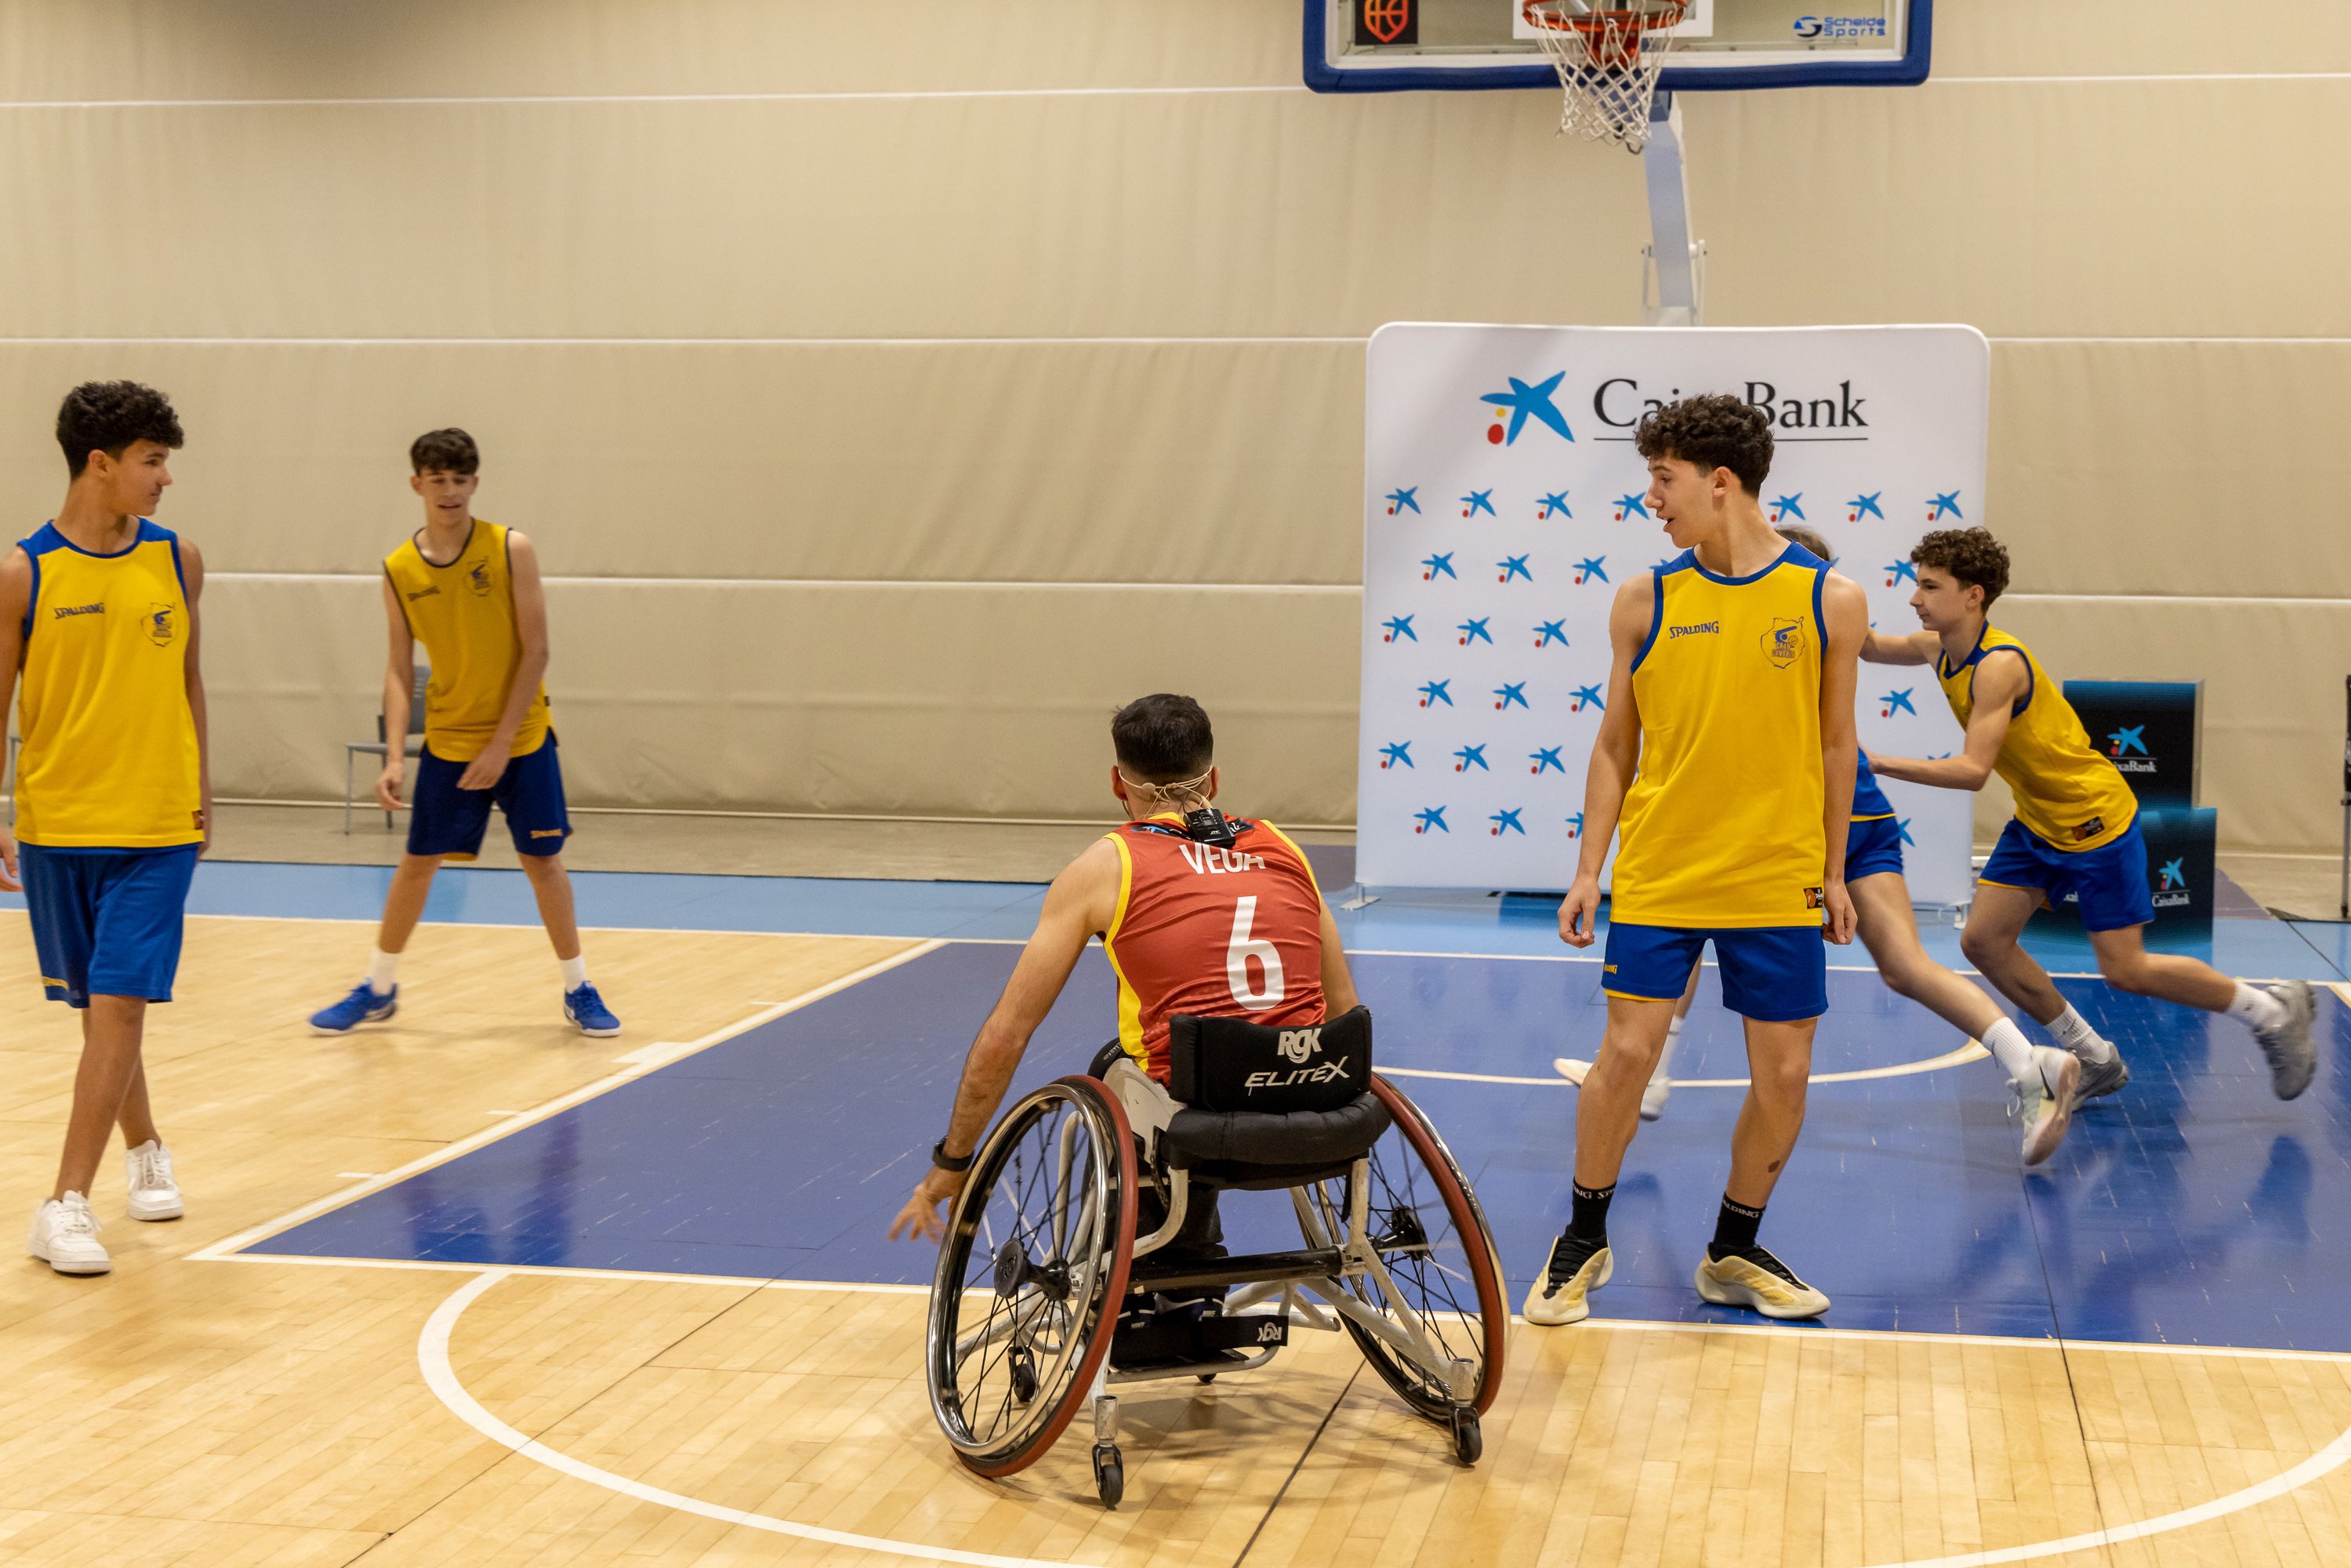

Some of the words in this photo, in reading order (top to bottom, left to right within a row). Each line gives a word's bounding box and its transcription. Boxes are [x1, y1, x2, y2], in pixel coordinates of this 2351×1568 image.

[1823, 27, 1886, 38] Sports
[54, 602, 105, 619] SPALDING
[1669, 621, 1719, 639] SPALDING
[1178, 841, 1266, 875] VEGA
[1227, 895, 1285, 1011] 6
[1277, 1028, 1322, 1064] RGK
